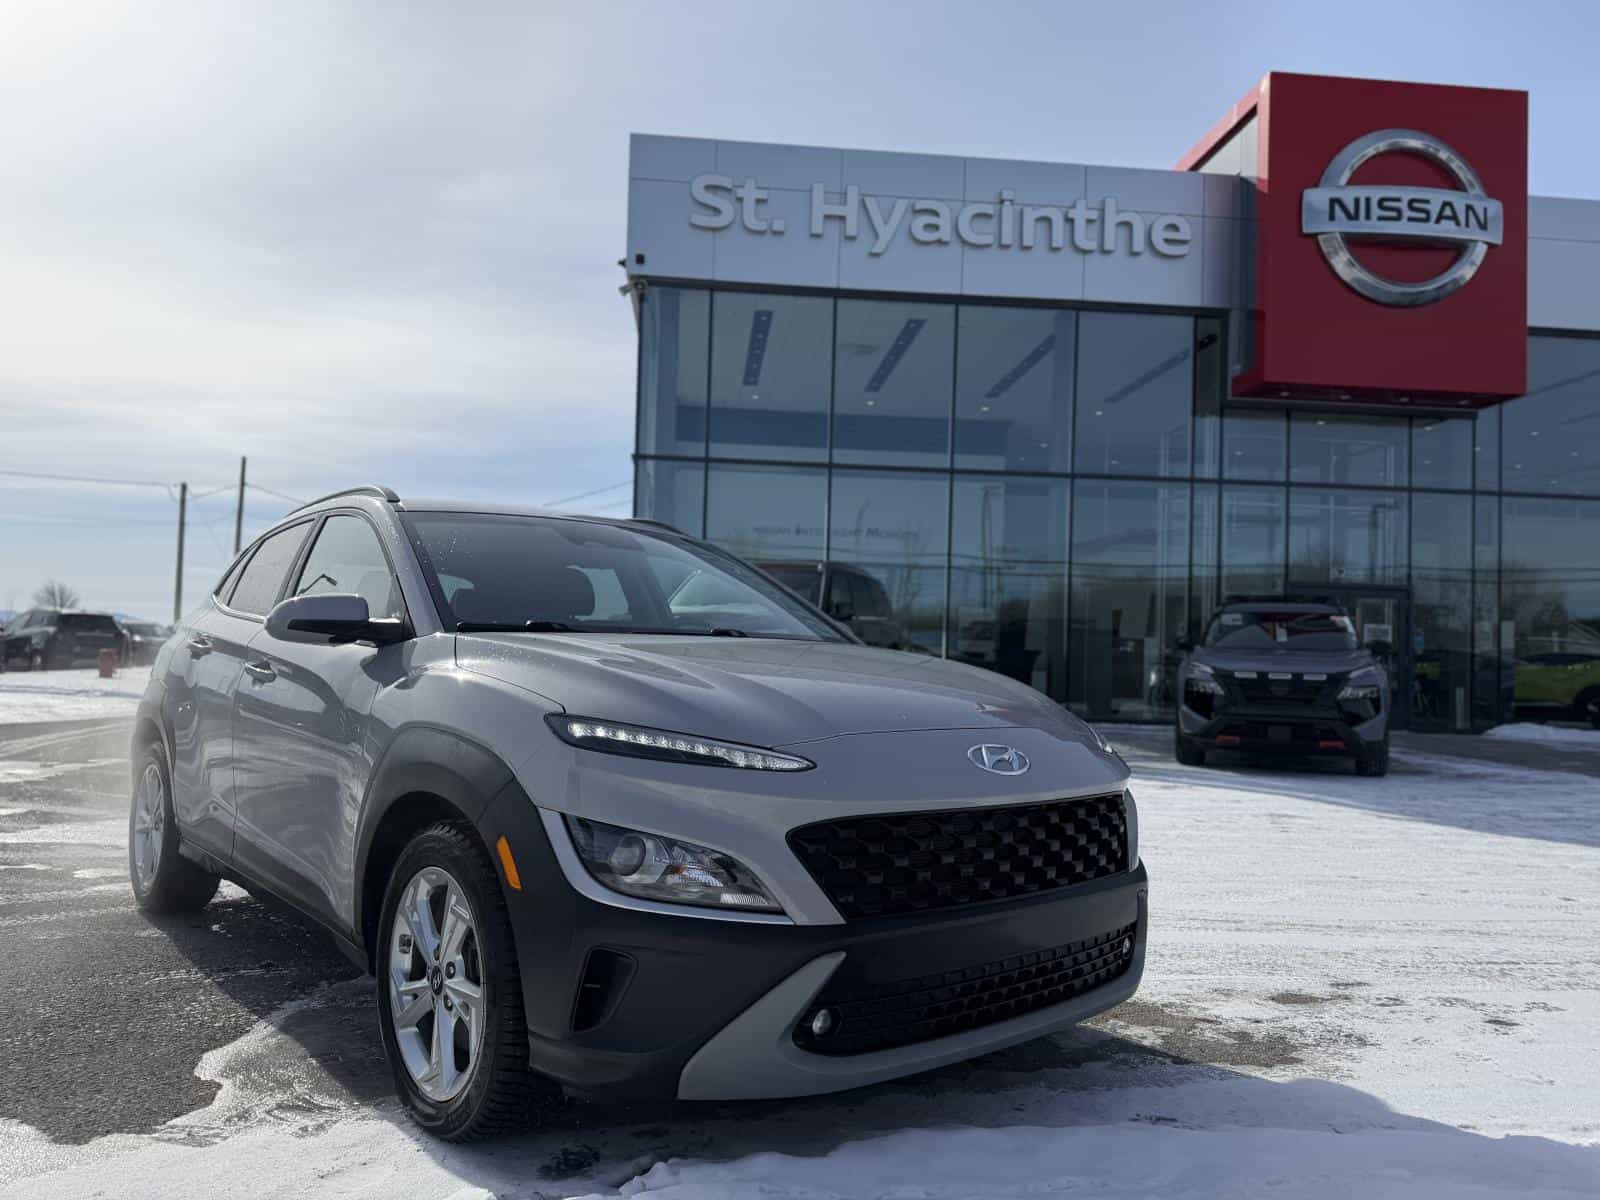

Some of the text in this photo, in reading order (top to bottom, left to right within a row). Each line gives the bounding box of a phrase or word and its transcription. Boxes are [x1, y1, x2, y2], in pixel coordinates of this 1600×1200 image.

[690, 174, 1192, 257] St. Hyacinthe
[1328, 197, 1488, 231] NISSAN
